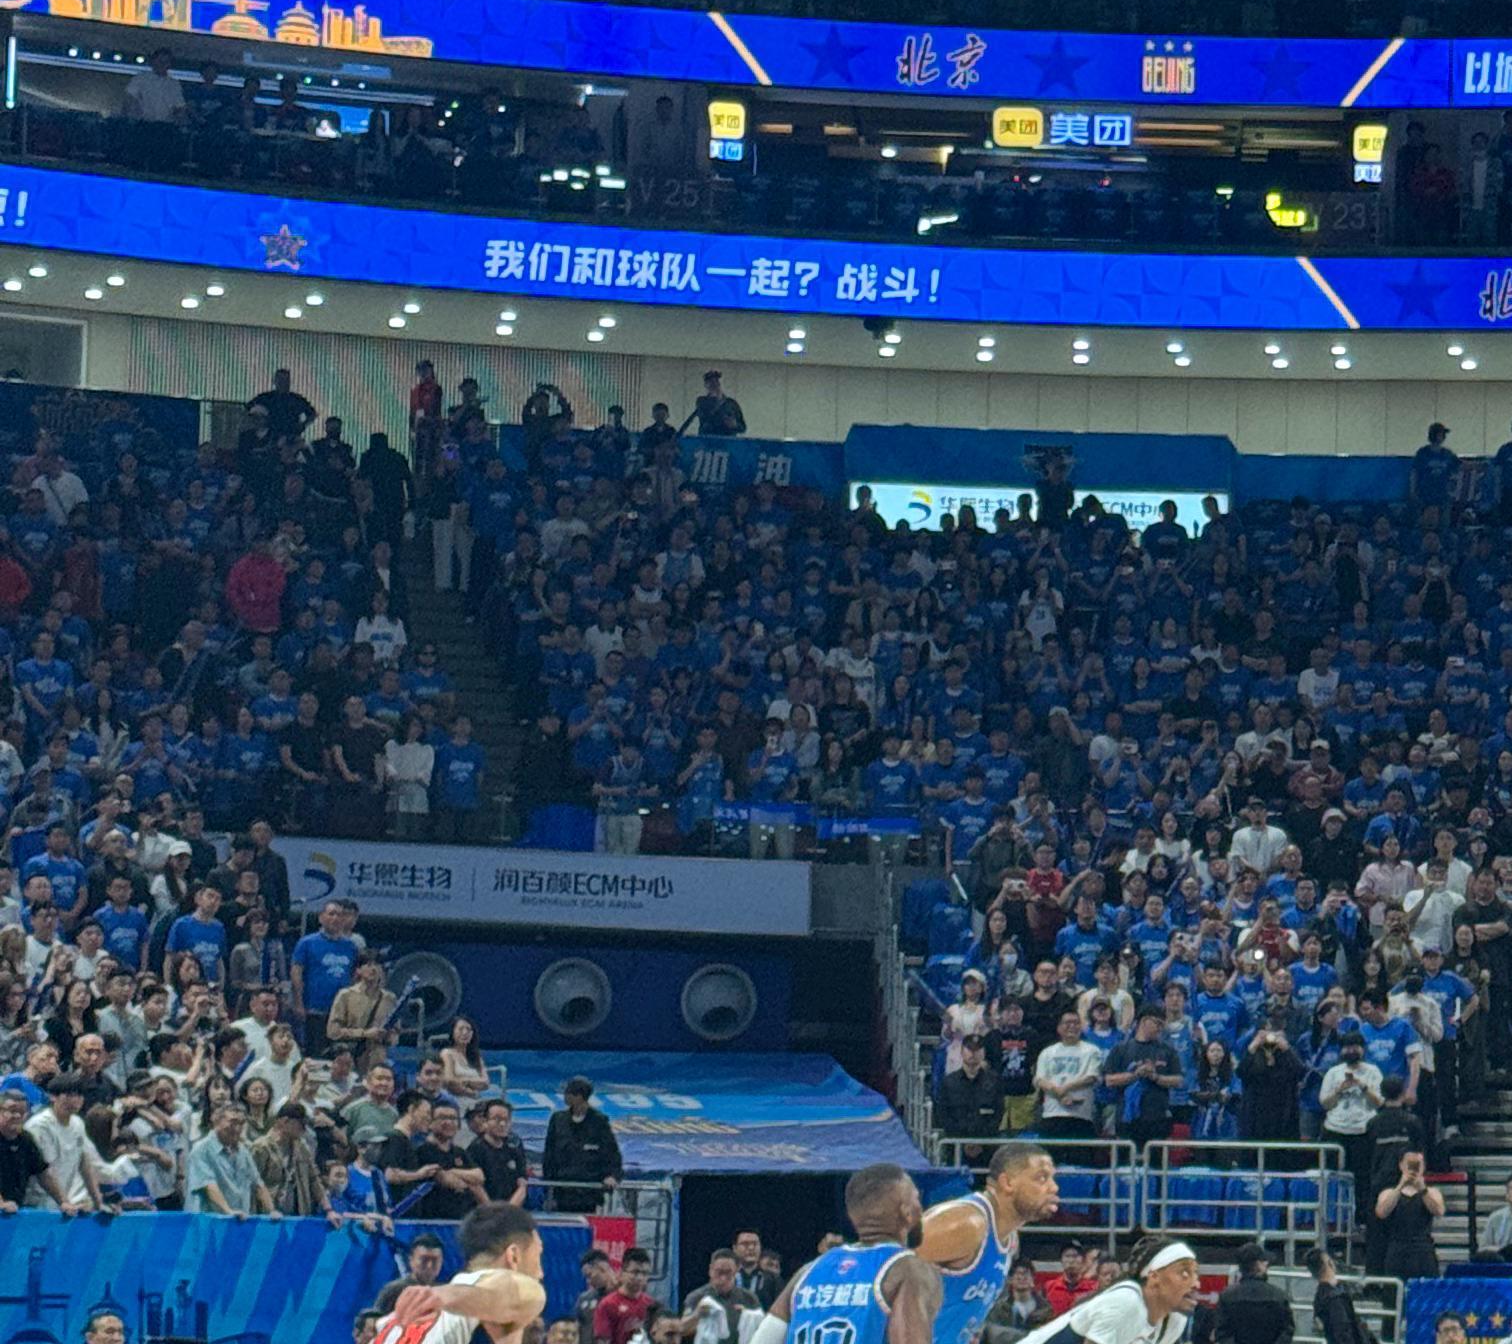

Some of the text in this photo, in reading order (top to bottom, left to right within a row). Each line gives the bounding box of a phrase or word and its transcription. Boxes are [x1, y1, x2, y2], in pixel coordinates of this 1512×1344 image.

[896, 33, 987, 89] 北京
[1050, 113, 1132, 145] 美团
[348, 861, 674, 900] 华熙生物 润百颜ECM中心
